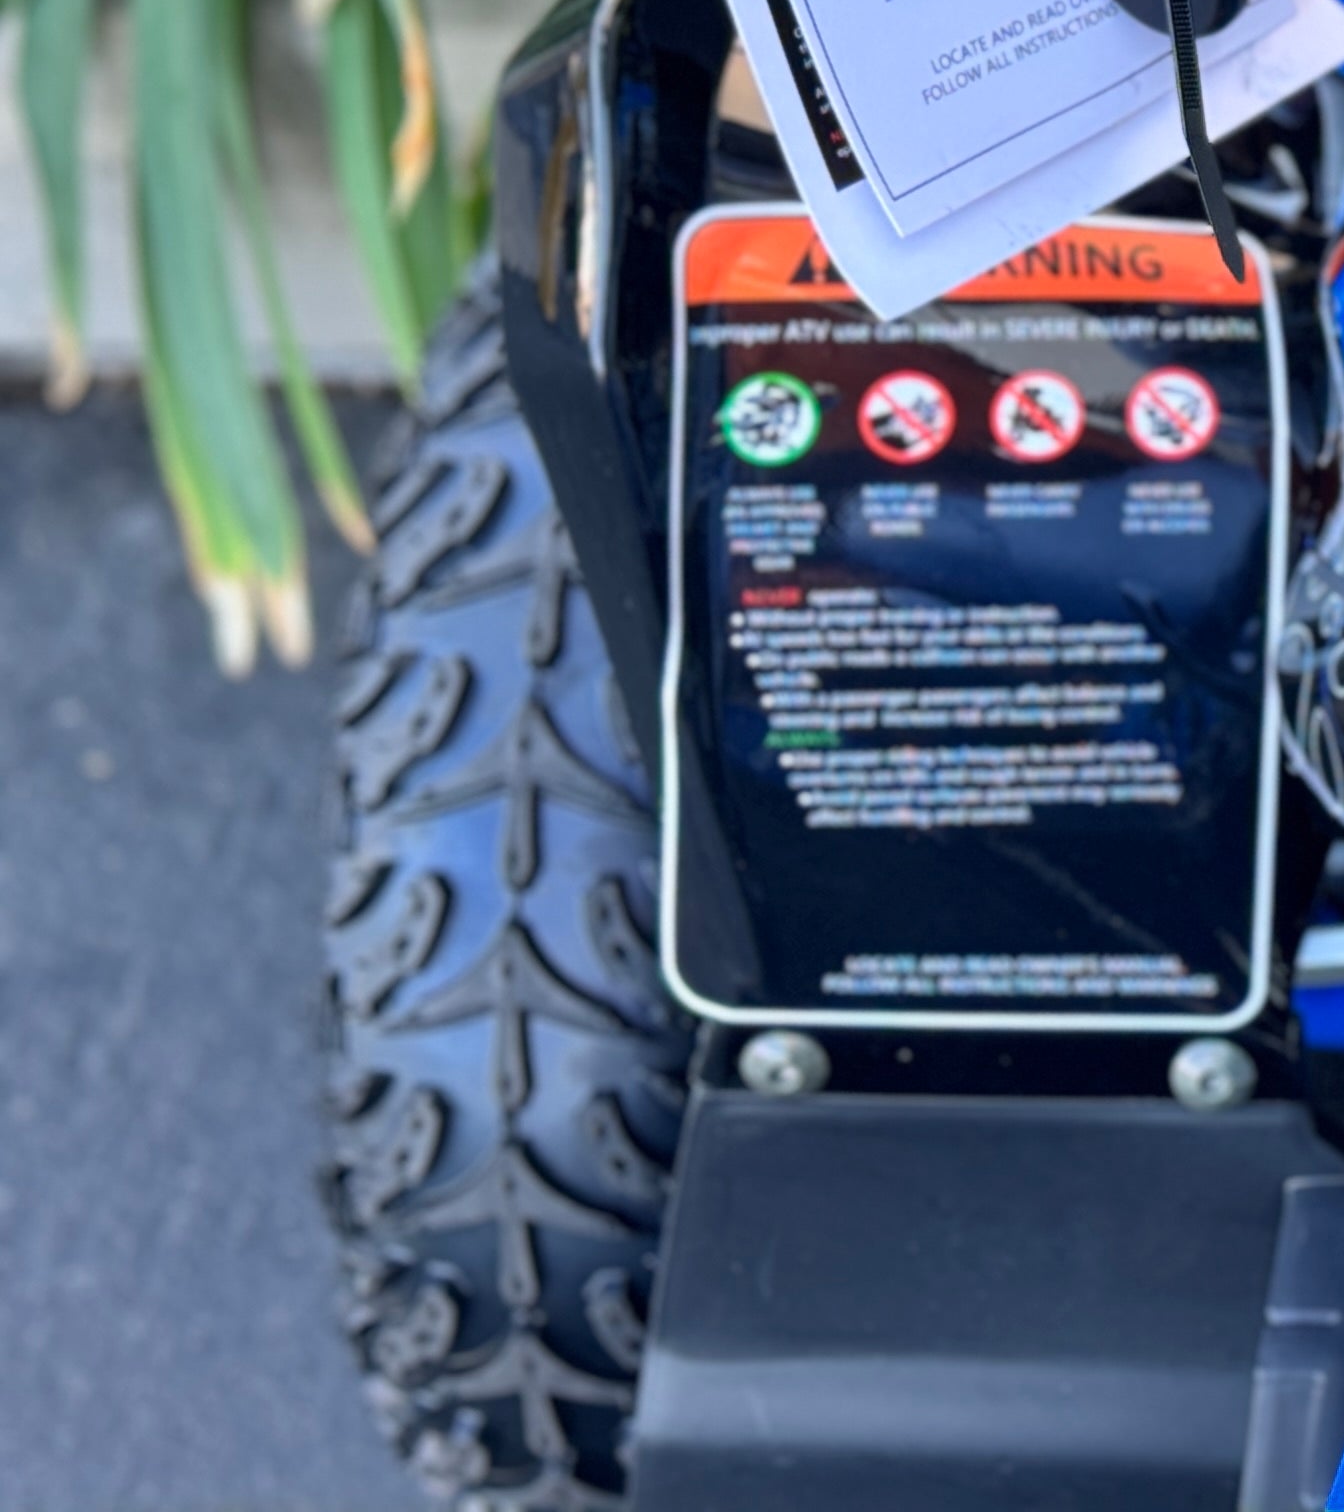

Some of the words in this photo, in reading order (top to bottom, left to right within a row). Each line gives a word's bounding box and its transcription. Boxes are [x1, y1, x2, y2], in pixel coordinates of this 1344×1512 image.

[931, 36, 988, 75] LOCATE
[992, 19, 1025, 47] AND
[1027, 0, 1067, 29] READ
[921, 63, 982, 105] FOLLOW
[987, 51, 1012, 75] ALL
